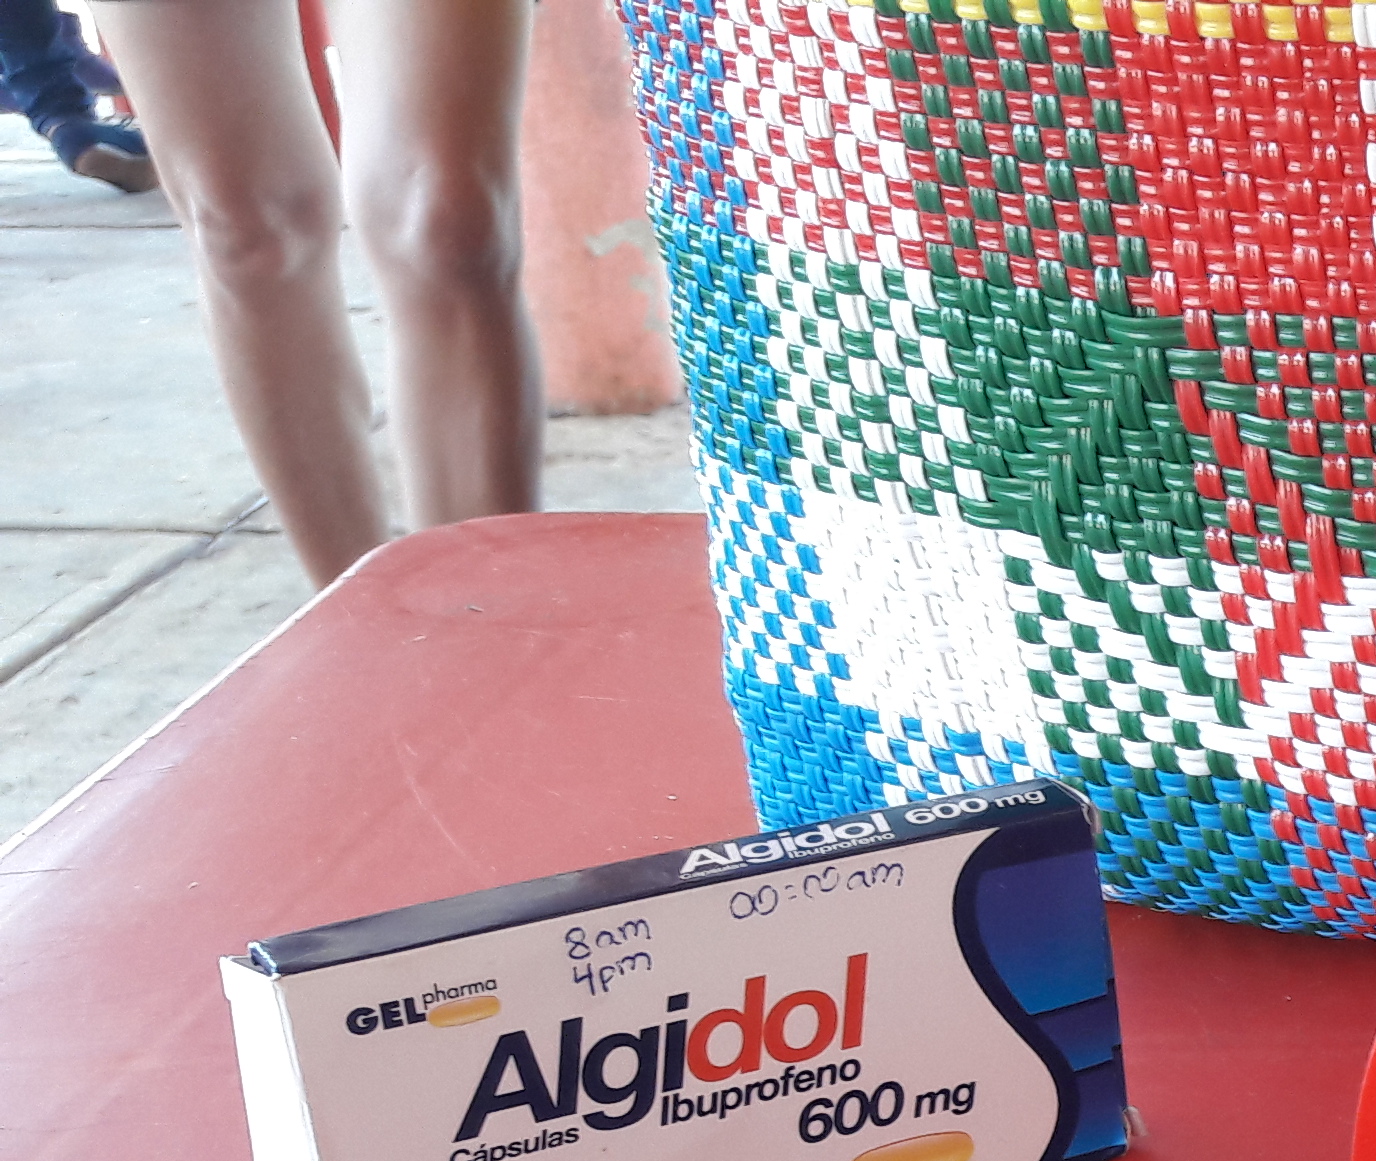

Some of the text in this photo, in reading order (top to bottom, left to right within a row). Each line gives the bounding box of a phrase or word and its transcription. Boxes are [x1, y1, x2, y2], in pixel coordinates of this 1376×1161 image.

[679, 812, 893, 876] Algidol
[904, 796, 992, 825] 600
[993, 790, 1047, 809] mg
[788, 832, 896, 860] Ibuprofeno
[422, 979, 498, 1010] pharma
[452, 952, 869, 1144] Algidol
[660, 1059, 862, 1128] Ibuprofeno
[799, 1080, 977, 1144] 600 mg
